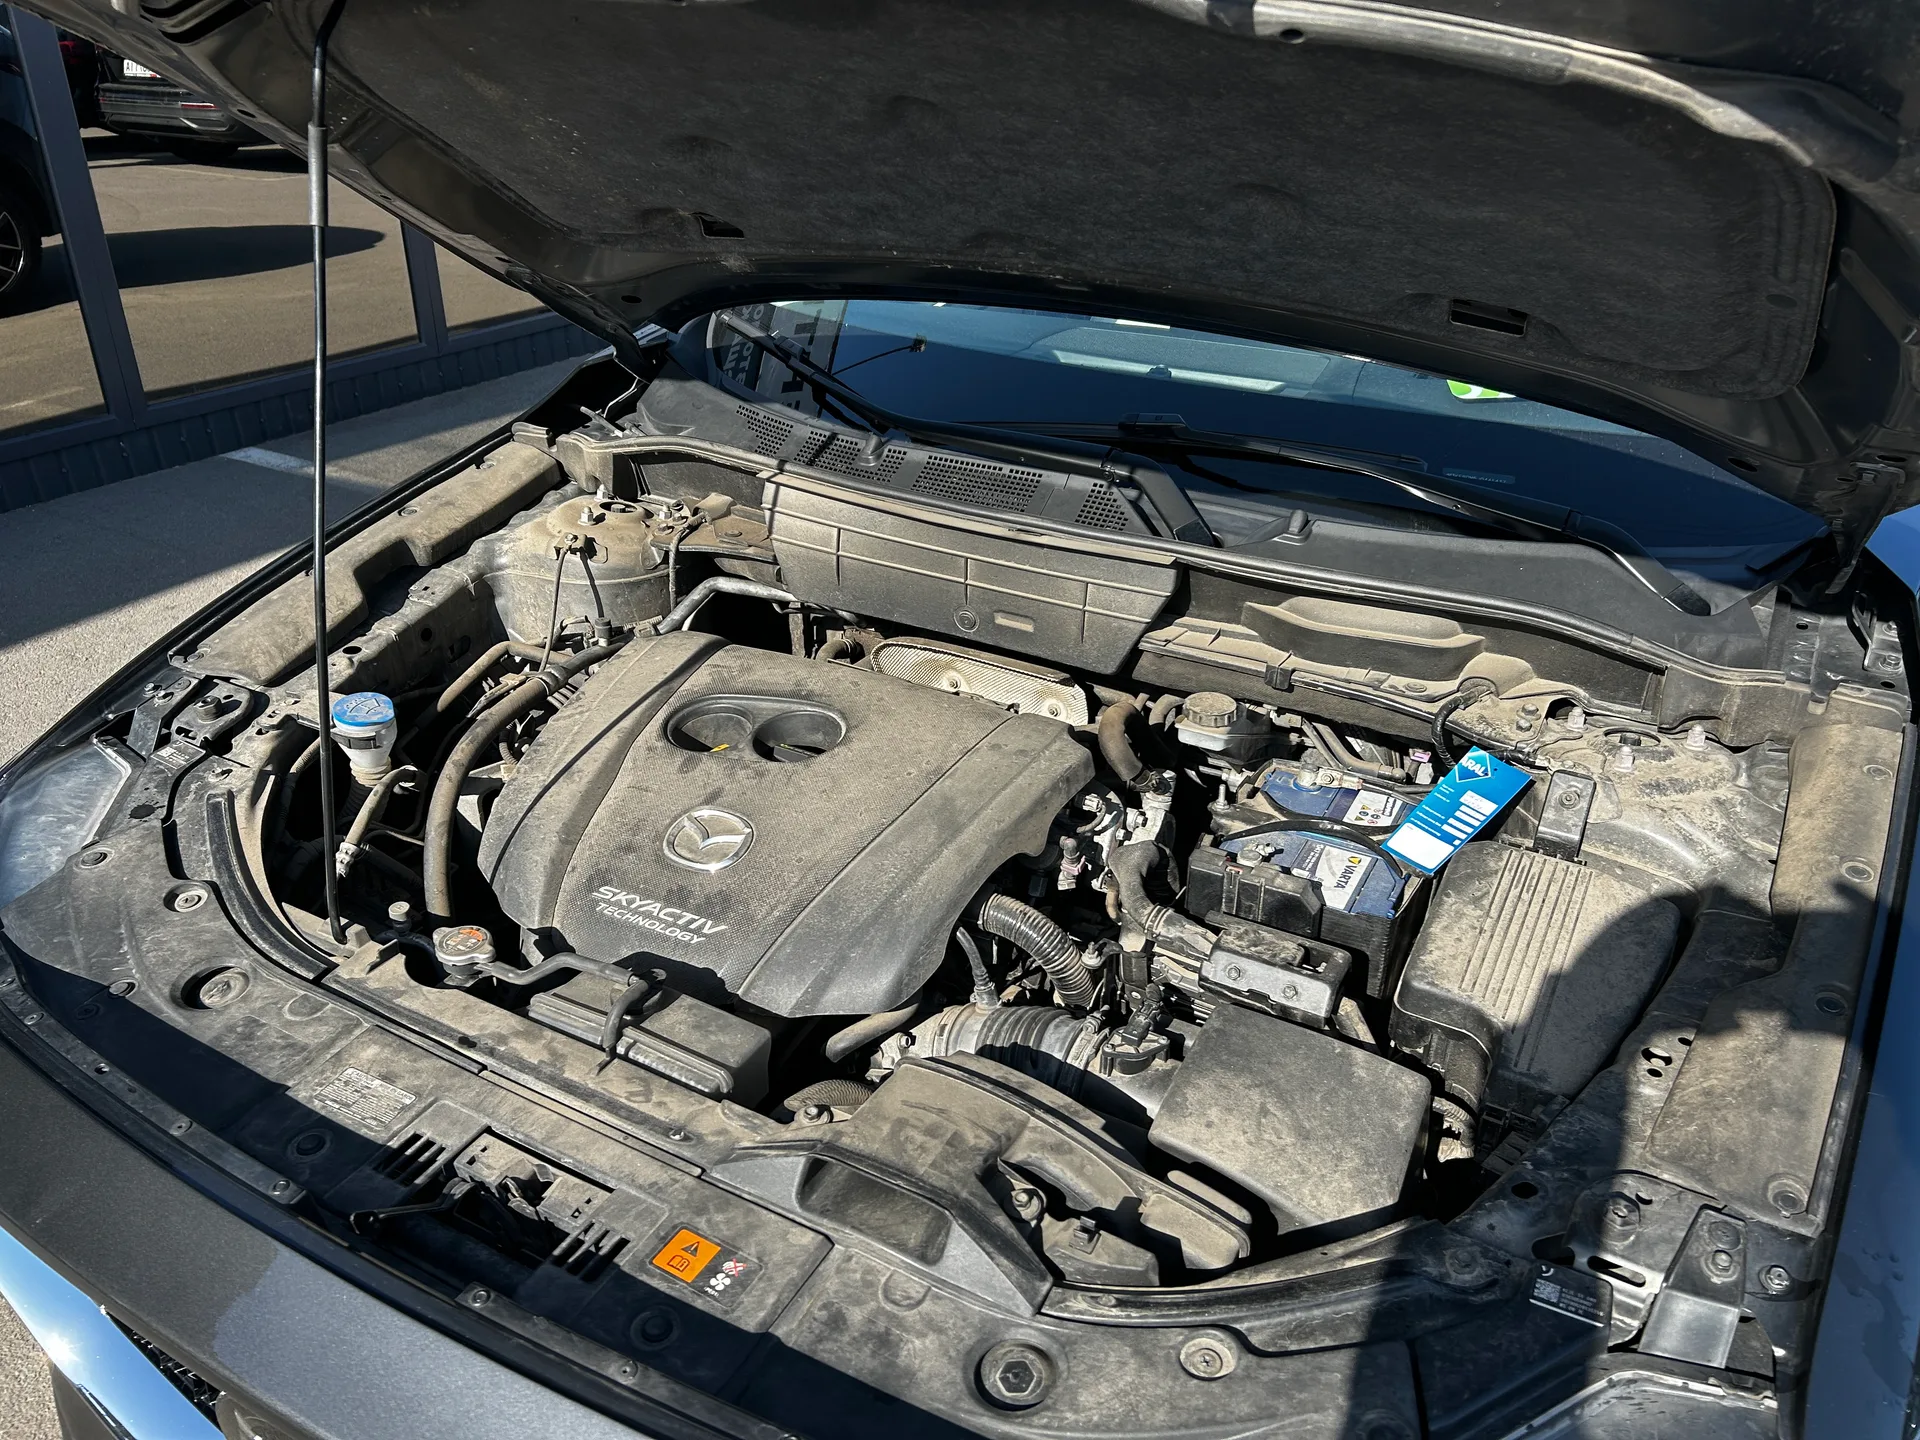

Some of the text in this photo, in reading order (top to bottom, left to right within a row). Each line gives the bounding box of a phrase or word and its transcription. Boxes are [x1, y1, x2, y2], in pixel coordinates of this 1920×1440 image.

[1334, 865, 1358, 889] VARTA
[592, 886, 728, 934] SKYACTIV
[595, 903, 706, 944] TECHNOLOGY
